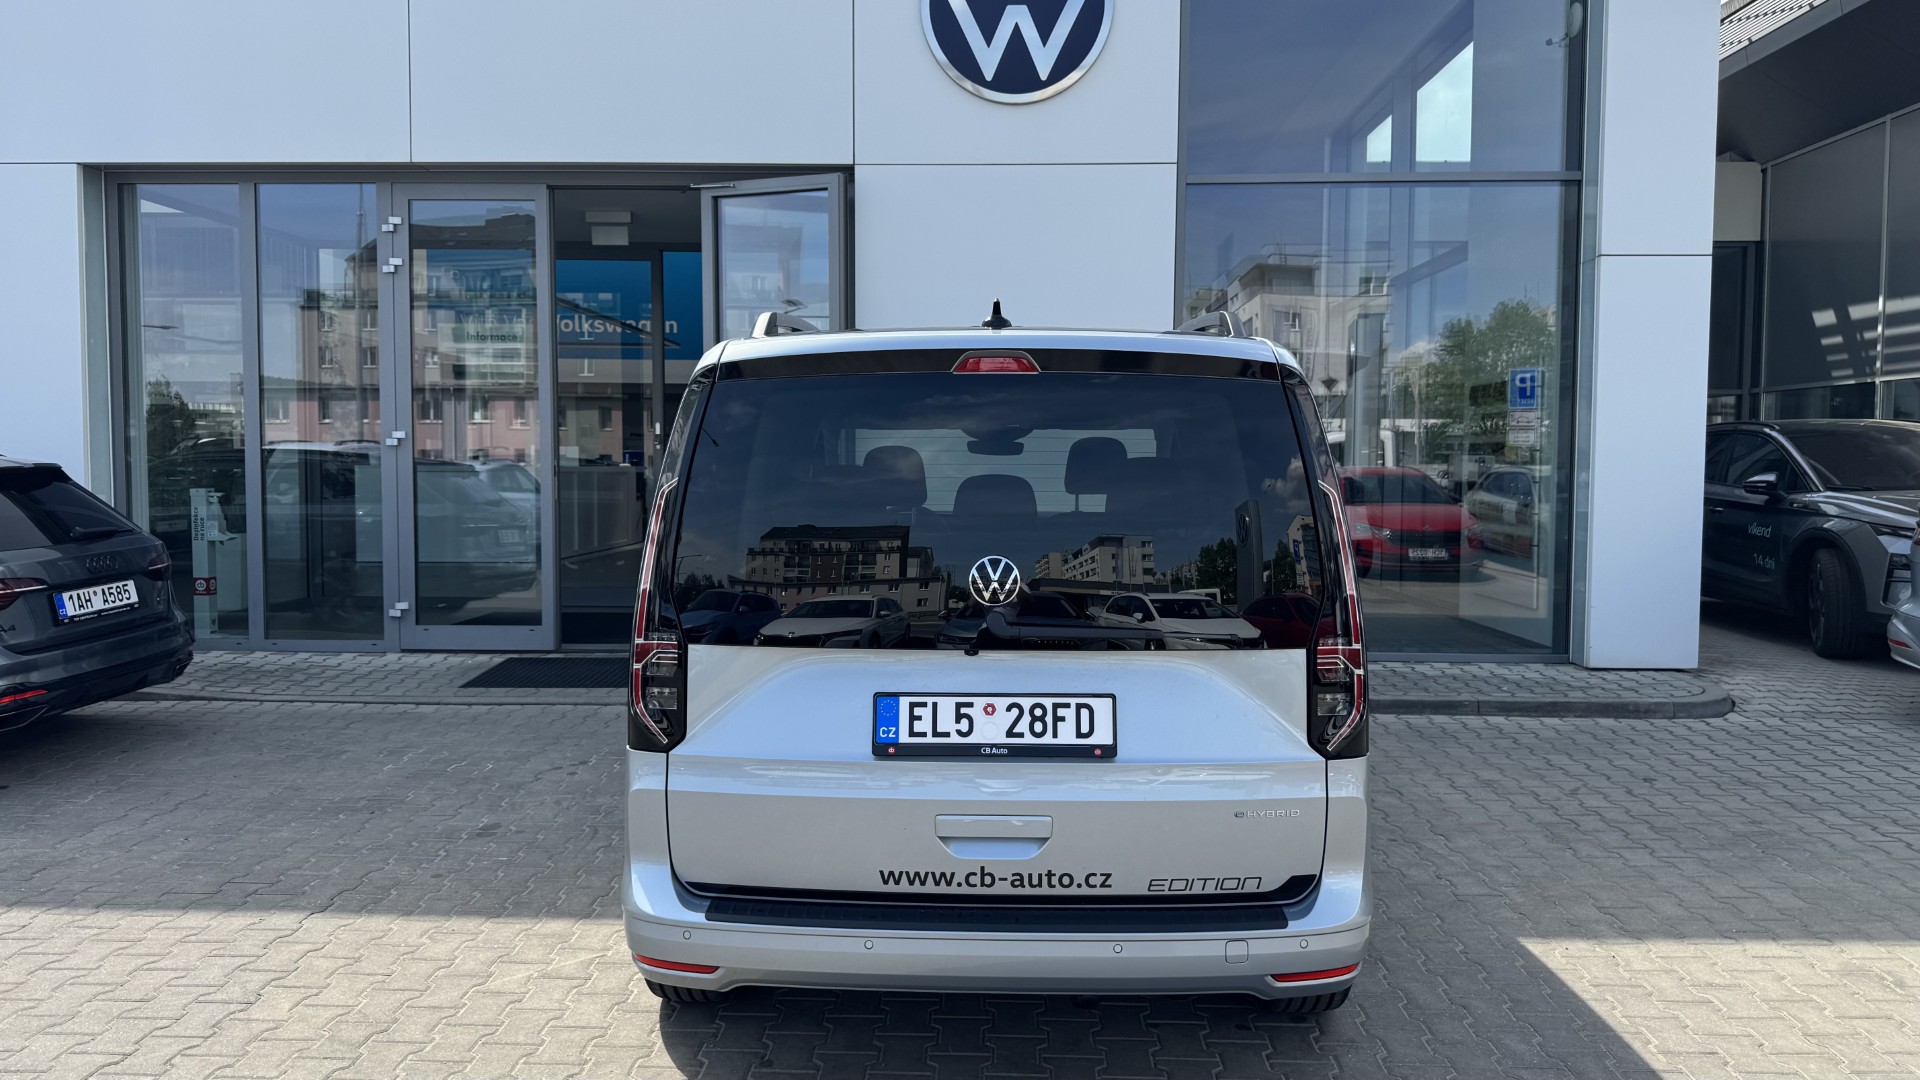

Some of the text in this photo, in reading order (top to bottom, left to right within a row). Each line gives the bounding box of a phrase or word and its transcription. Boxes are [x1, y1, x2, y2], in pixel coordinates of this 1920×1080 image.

[557, 313, 679, 338] olkswagn
[466, 331, 518, 342] Informace
[199, 532, 205, 541] na
[1753, 553, 1763, 567] 14
[68, 583, 131, 613] 1AH A585
[908, 701, 1095, 739] EL5 28FD
[879, 727, 897, 738] CZ
[878, 866, 1113, 889] www.cb-auto.cz
[1147, 876, 1262, 893] EDITION
